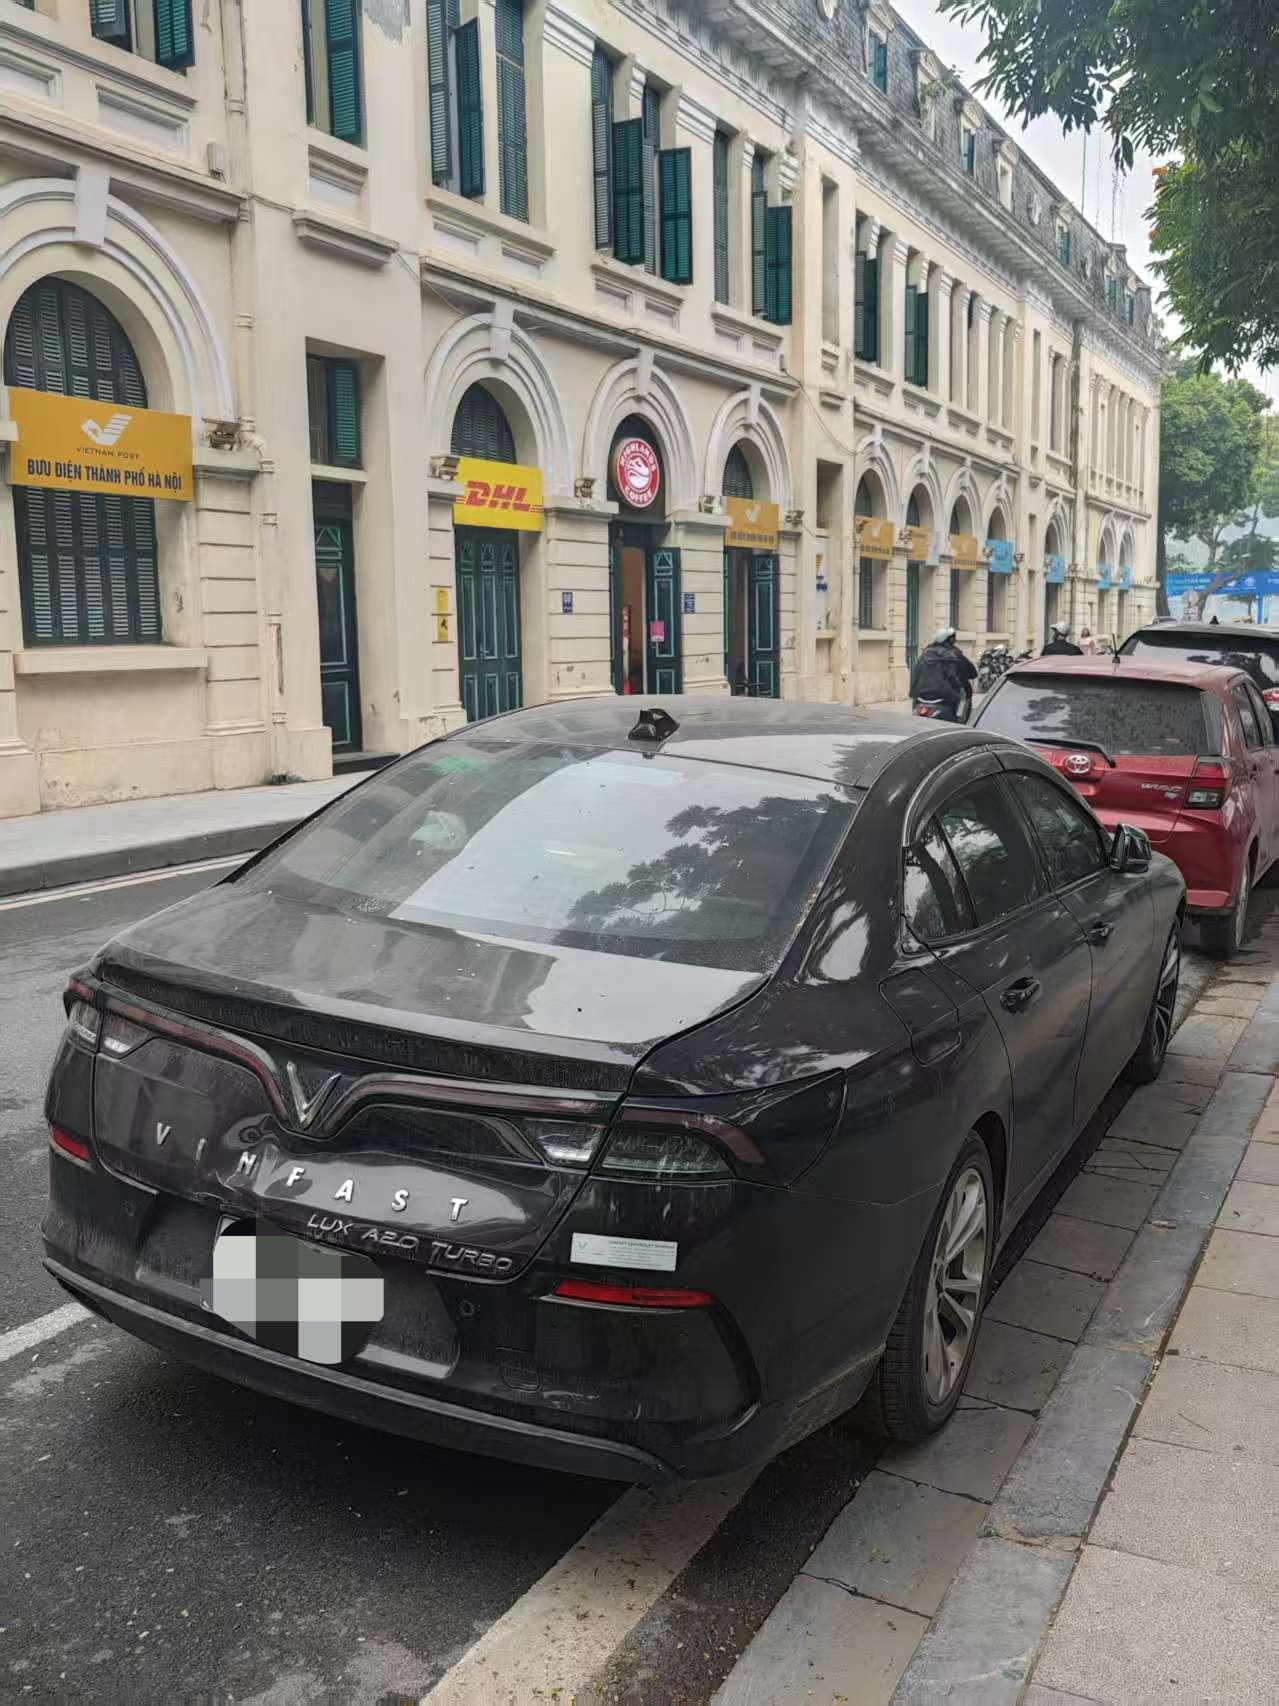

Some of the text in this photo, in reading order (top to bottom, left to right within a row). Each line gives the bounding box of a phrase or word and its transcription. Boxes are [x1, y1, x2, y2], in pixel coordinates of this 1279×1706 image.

[75, 447, 139, 459] VIETNAM POST
[620, 442, 657, 472] HIGHLANDS
[55, 460, 82, 482] ĐIỆN
[84, 464, 121, 484] THÀNH
[124, 466, 145, 487] PHỐ
[148, 470, 161, 488] HÀ
[164, 472, 182, 493] NỘI
[465, 480, 529, 512] DHL
[625, 485, 652, 503] COFFEE
[157, 1122, 468, 1220] VINFAST
[307, 1214, 354, 1235] LUX
[430, 1241, 513, 1271] TURBO
